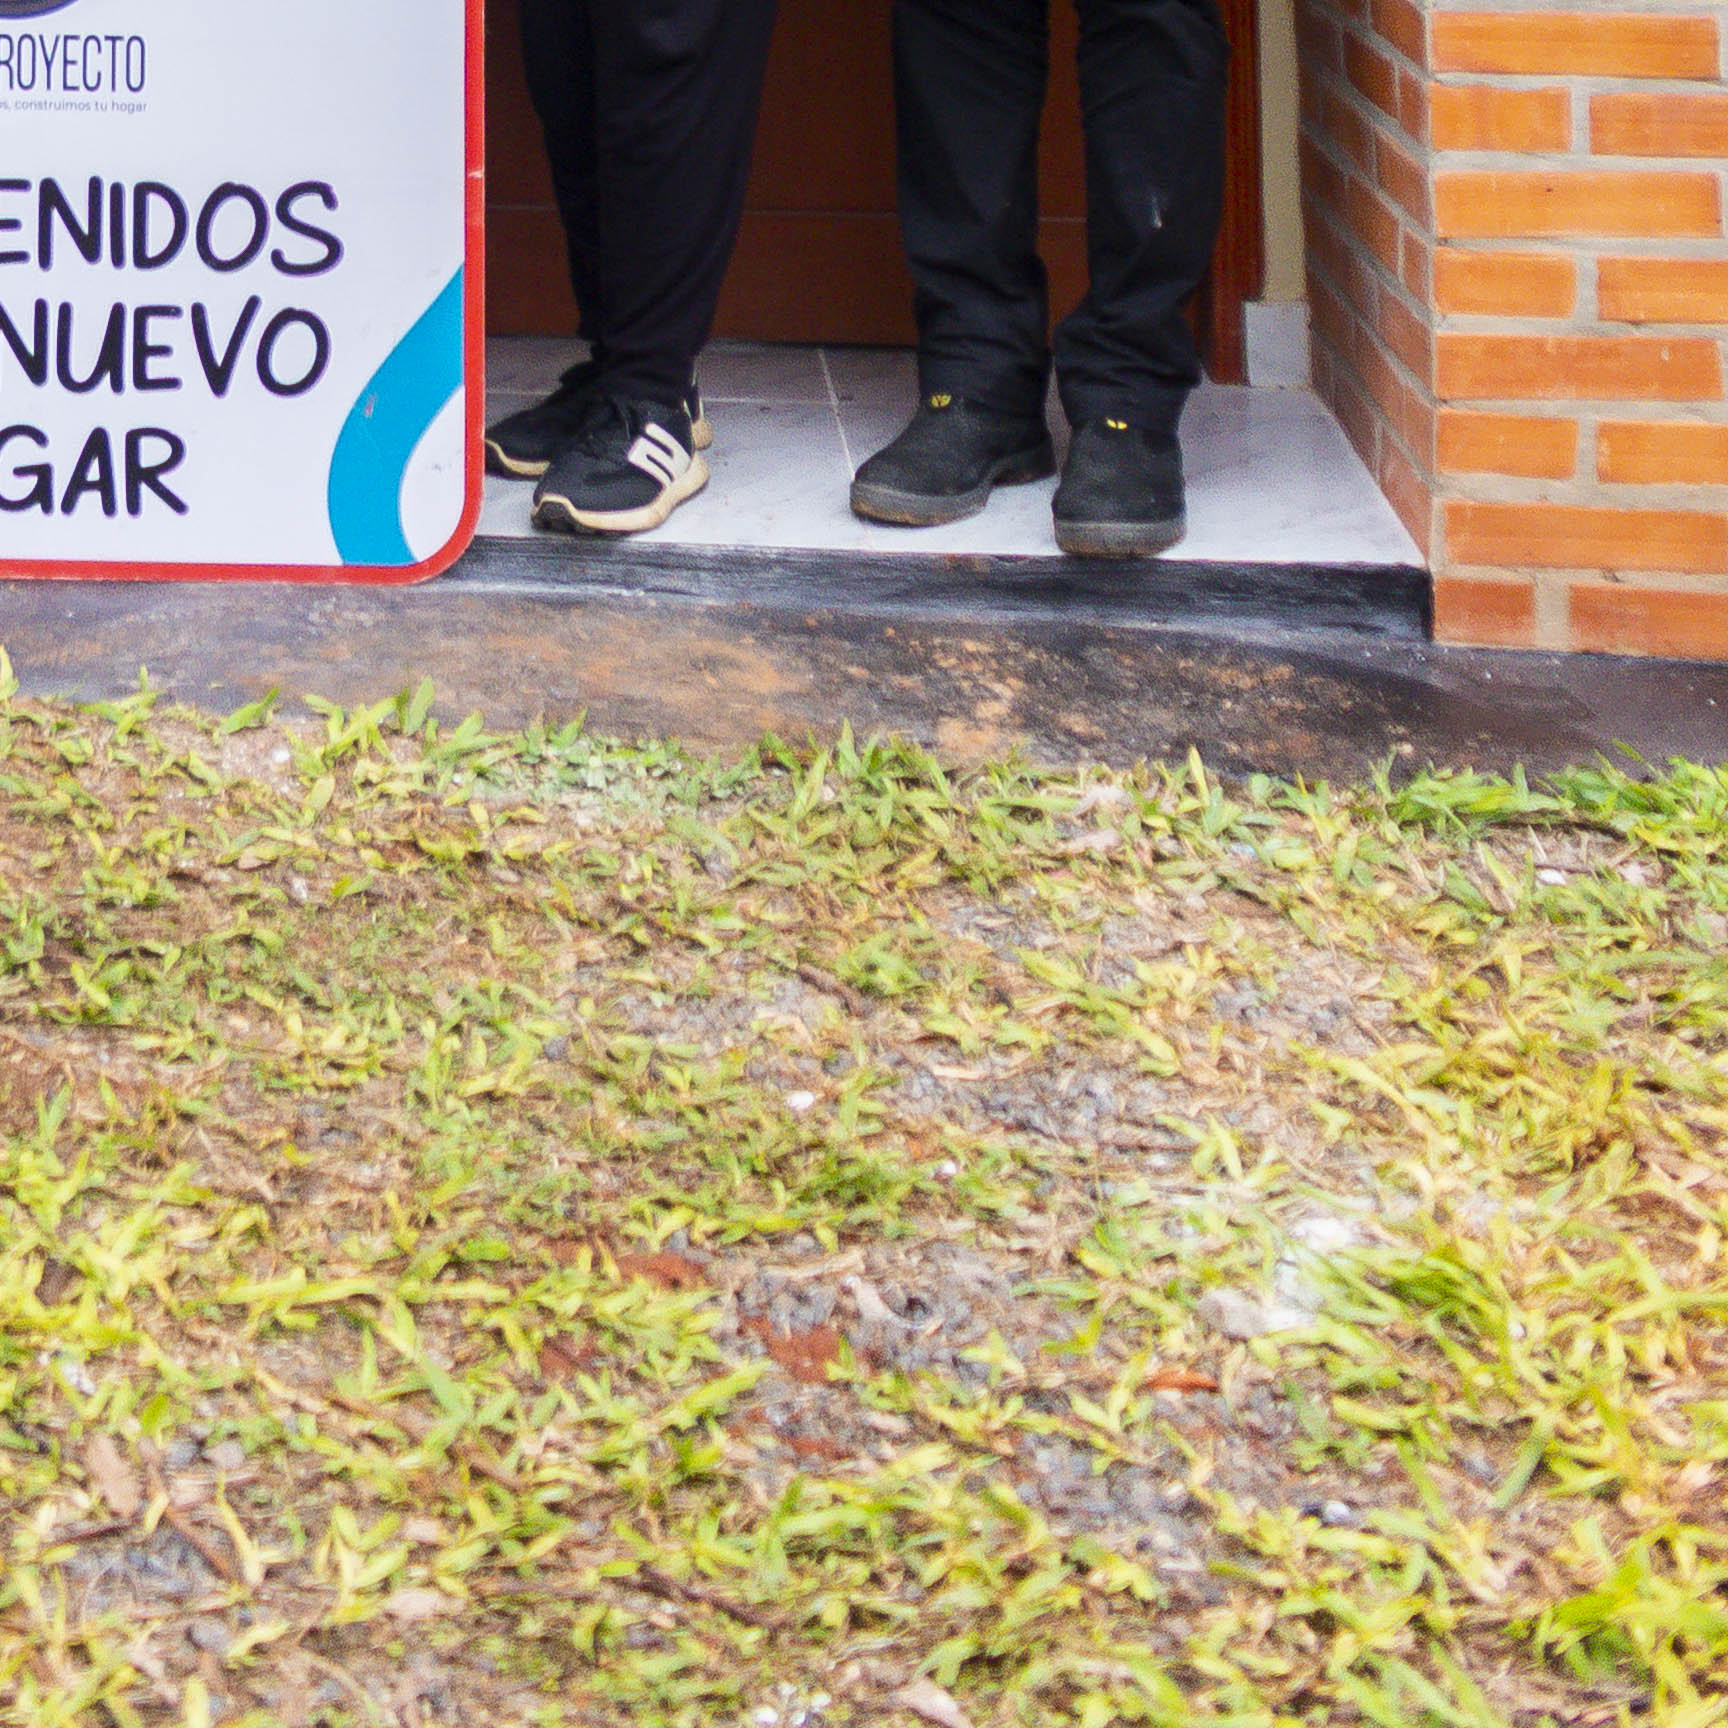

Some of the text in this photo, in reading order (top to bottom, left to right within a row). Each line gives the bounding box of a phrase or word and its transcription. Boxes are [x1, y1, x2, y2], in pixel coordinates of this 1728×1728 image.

[14, 98, 92, 112] construimos
[94, 100, 109, 112] tu
[111, 99, 149, 115] hogar
